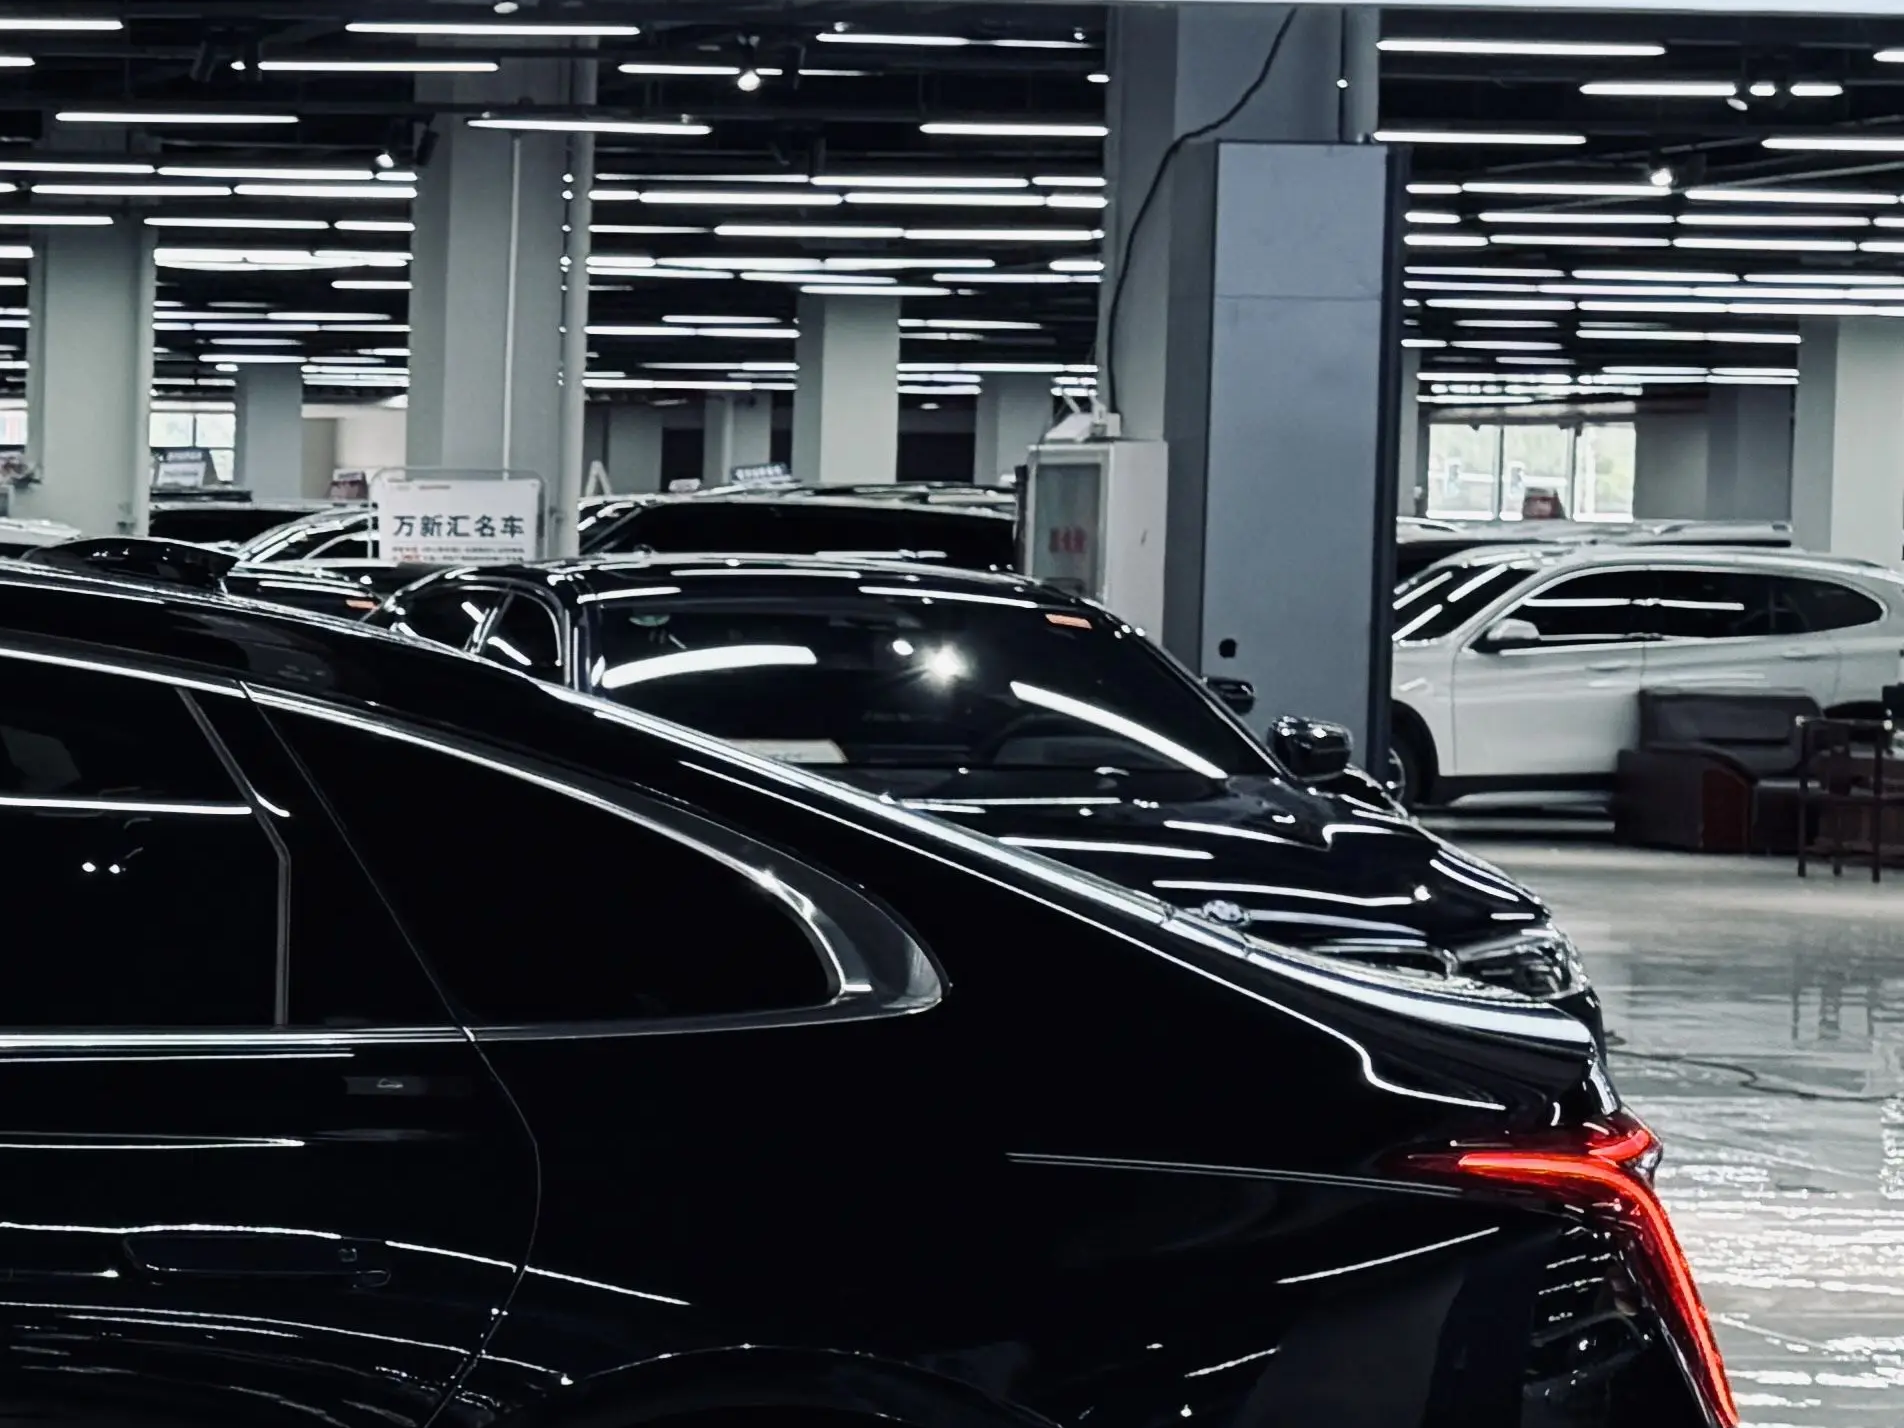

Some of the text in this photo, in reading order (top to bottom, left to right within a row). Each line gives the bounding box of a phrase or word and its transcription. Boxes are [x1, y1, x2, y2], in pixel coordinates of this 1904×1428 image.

[393, 514, 525, 539] 万新汇名车
